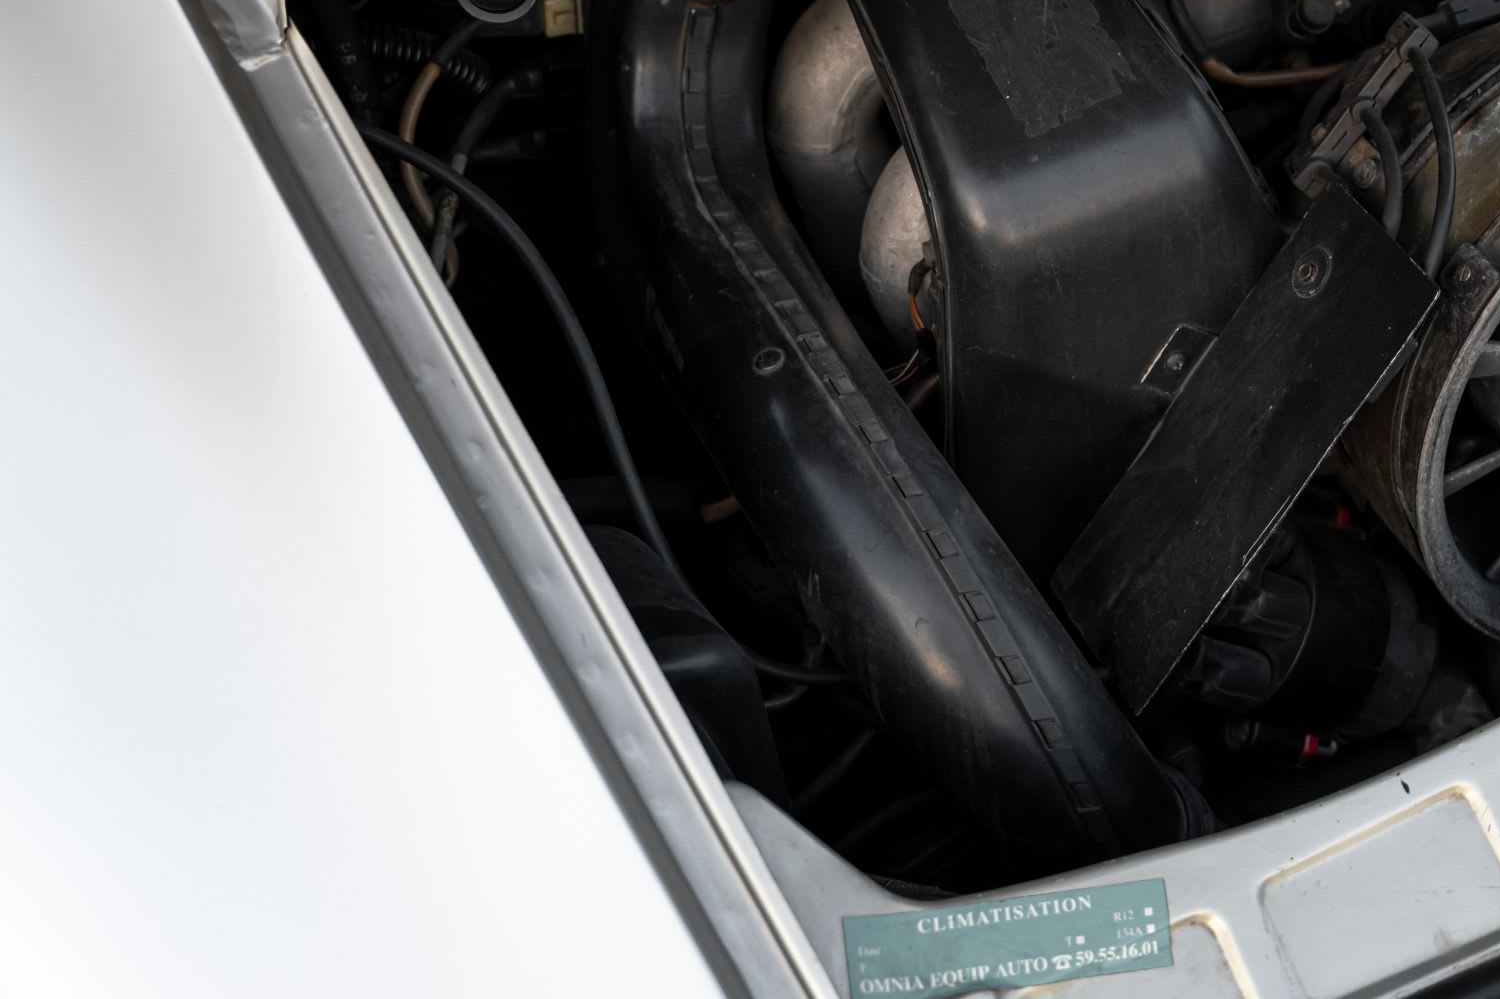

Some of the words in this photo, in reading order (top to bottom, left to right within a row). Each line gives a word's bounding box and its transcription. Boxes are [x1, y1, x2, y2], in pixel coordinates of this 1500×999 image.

[915, 894, 1093, 935] CLIMATISATION
[1112, 909, 1134, 922] R12
[1115, 924, 1143, 939] 134A
[858, 971, 924, 996] OMNIA
[929, 964, 991, 989] EQUIP
[994, 956, 1049, 977] AUTO
[1074, 940, 1159, 966] 59.55.16.01
